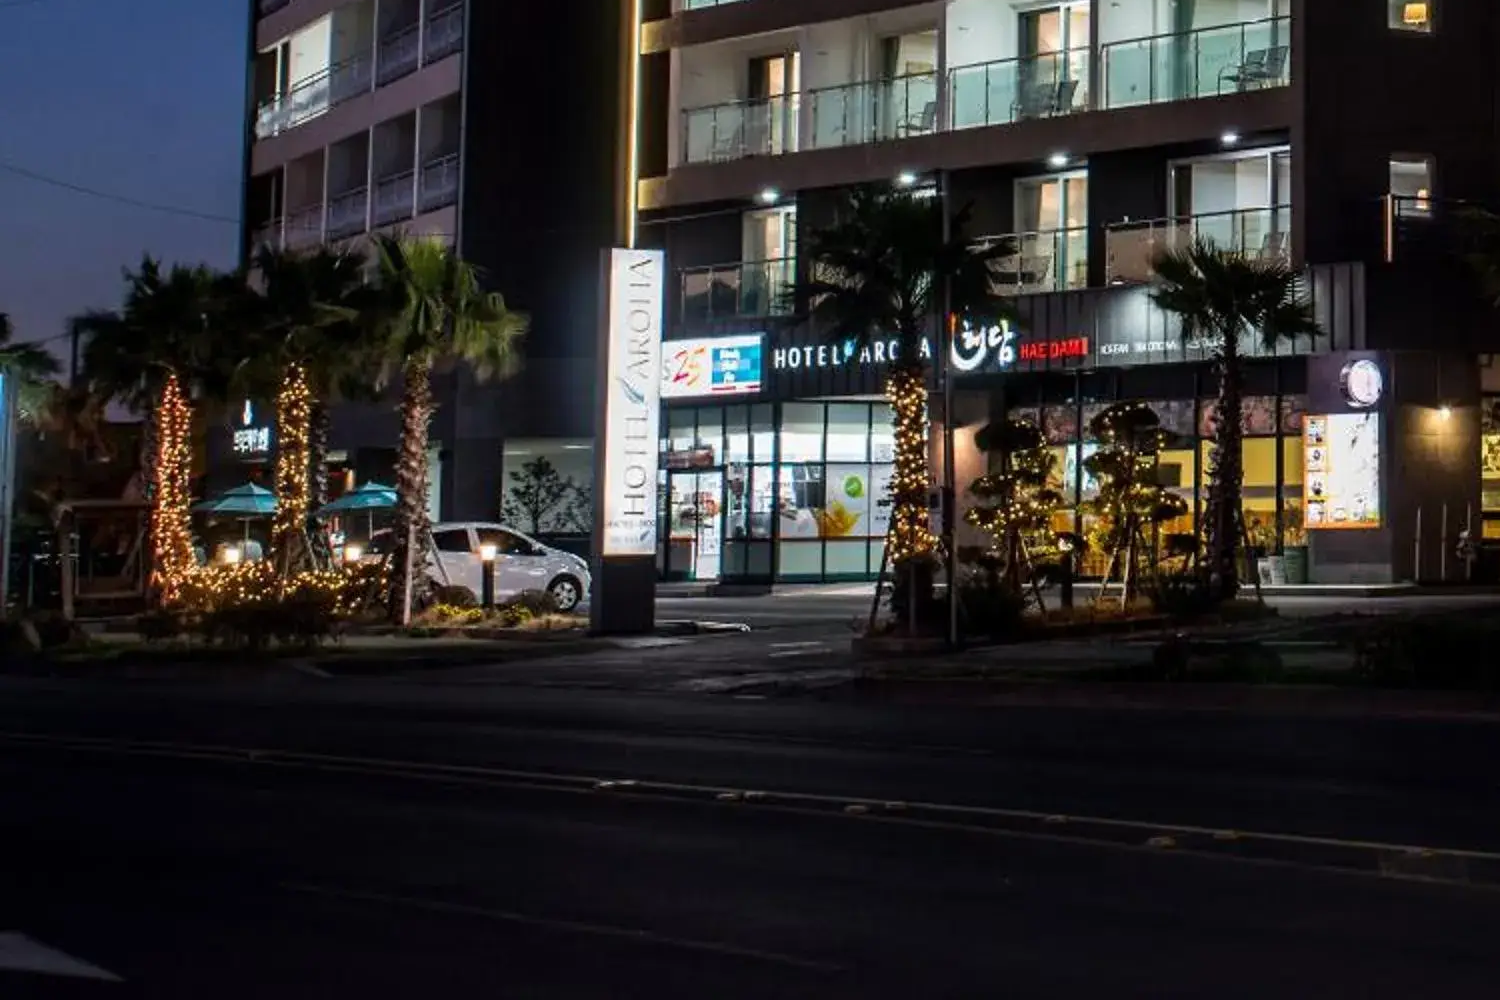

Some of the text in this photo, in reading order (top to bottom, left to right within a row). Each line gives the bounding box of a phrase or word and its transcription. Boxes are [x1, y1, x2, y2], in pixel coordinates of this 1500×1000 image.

[626, 257, 653, 380] AROHA
[773, 336, 931, 369] HOTEL AROA
[623, 407, 649, 516] HOTEL
